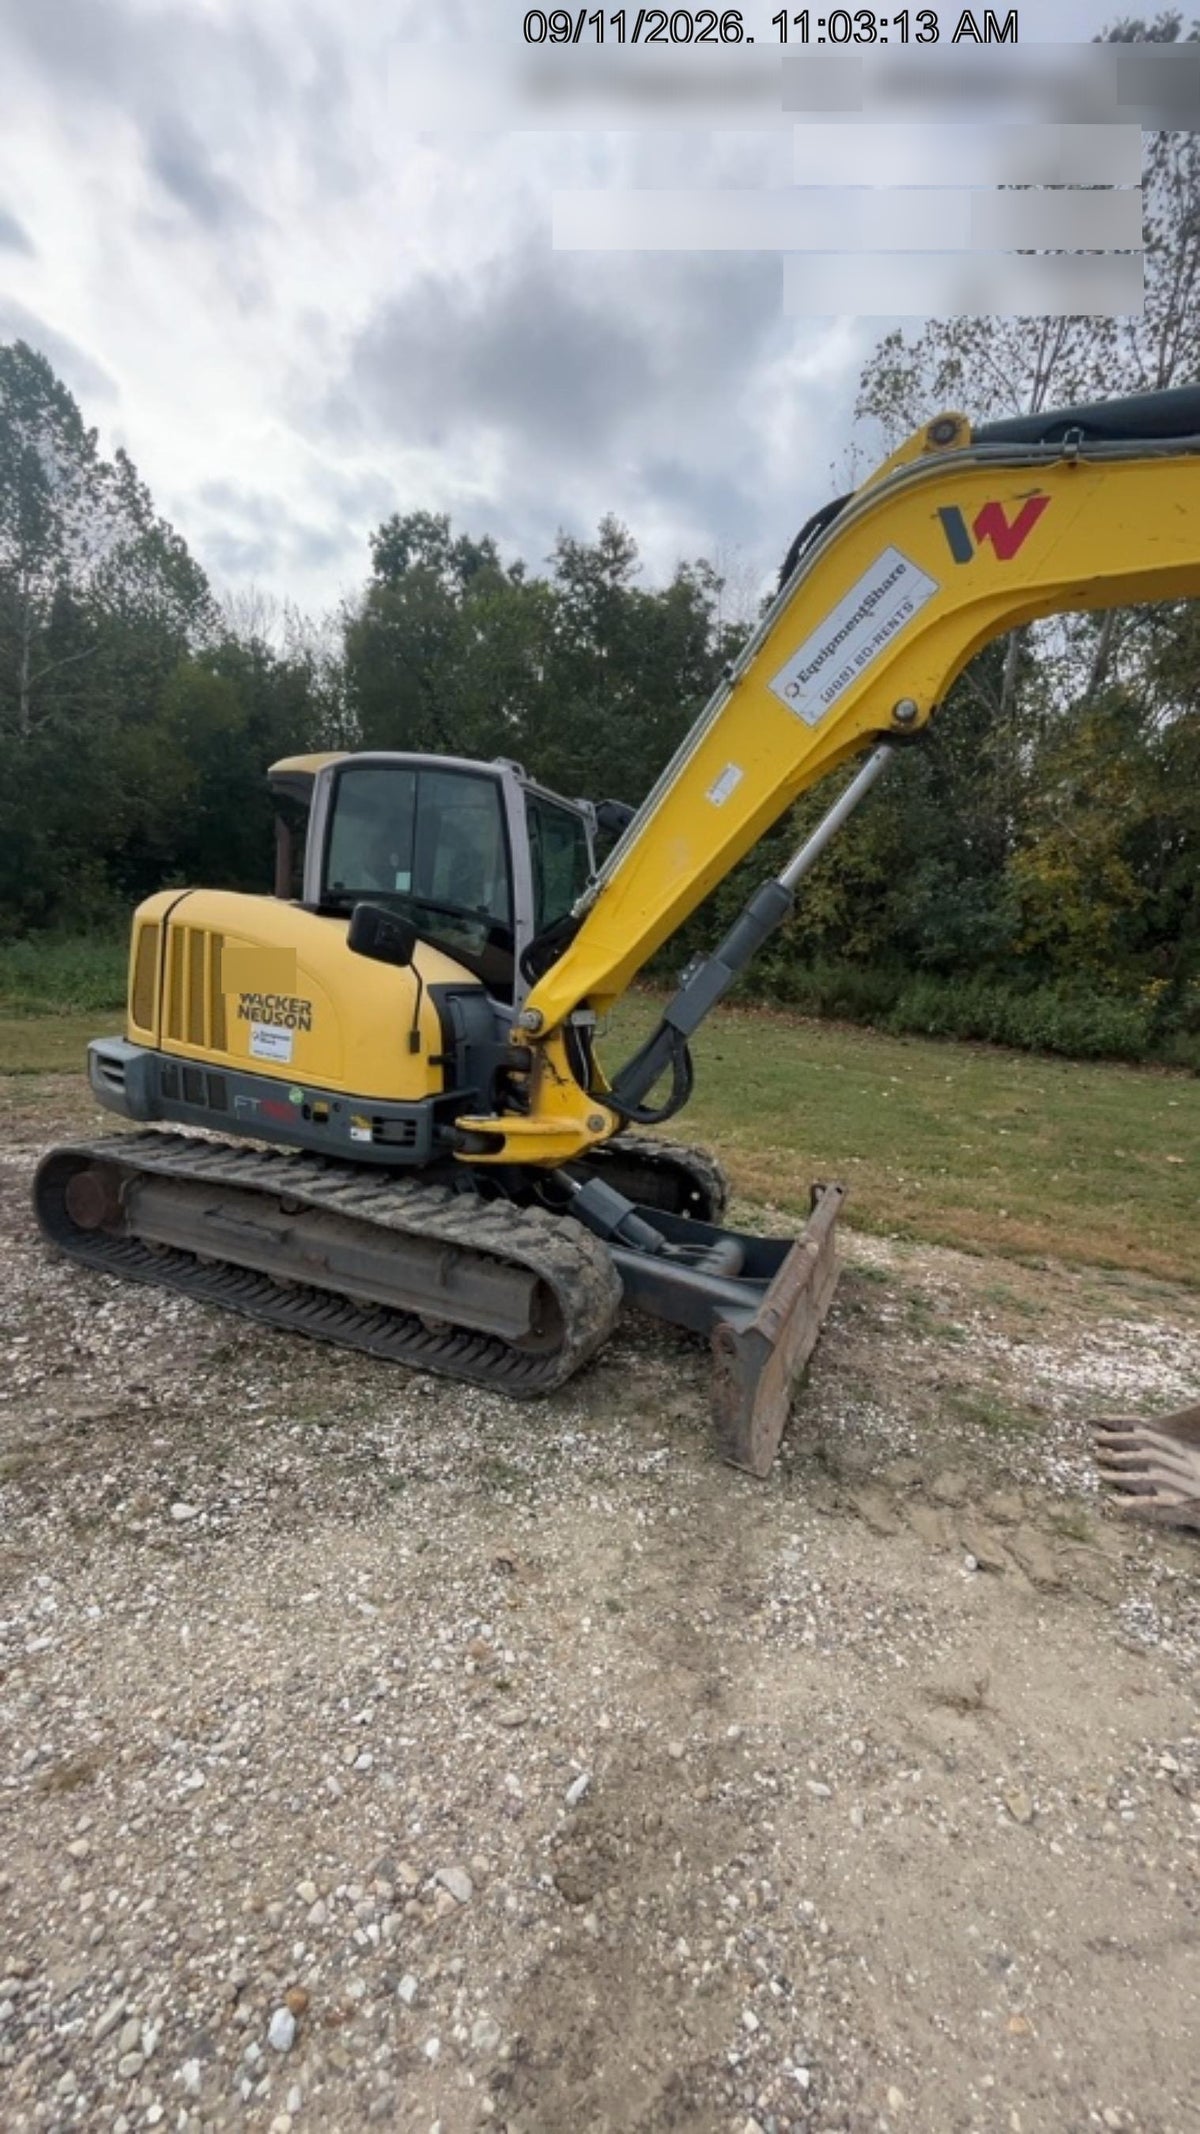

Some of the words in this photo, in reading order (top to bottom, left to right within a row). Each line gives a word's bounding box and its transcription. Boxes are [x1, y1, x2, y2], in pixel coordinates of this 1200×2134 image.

[797, 563, 907, 685] EquipmentShare
[237, 1004, 312, 1032] NEUSON
[239, 992, 312, 1016] WACKER
